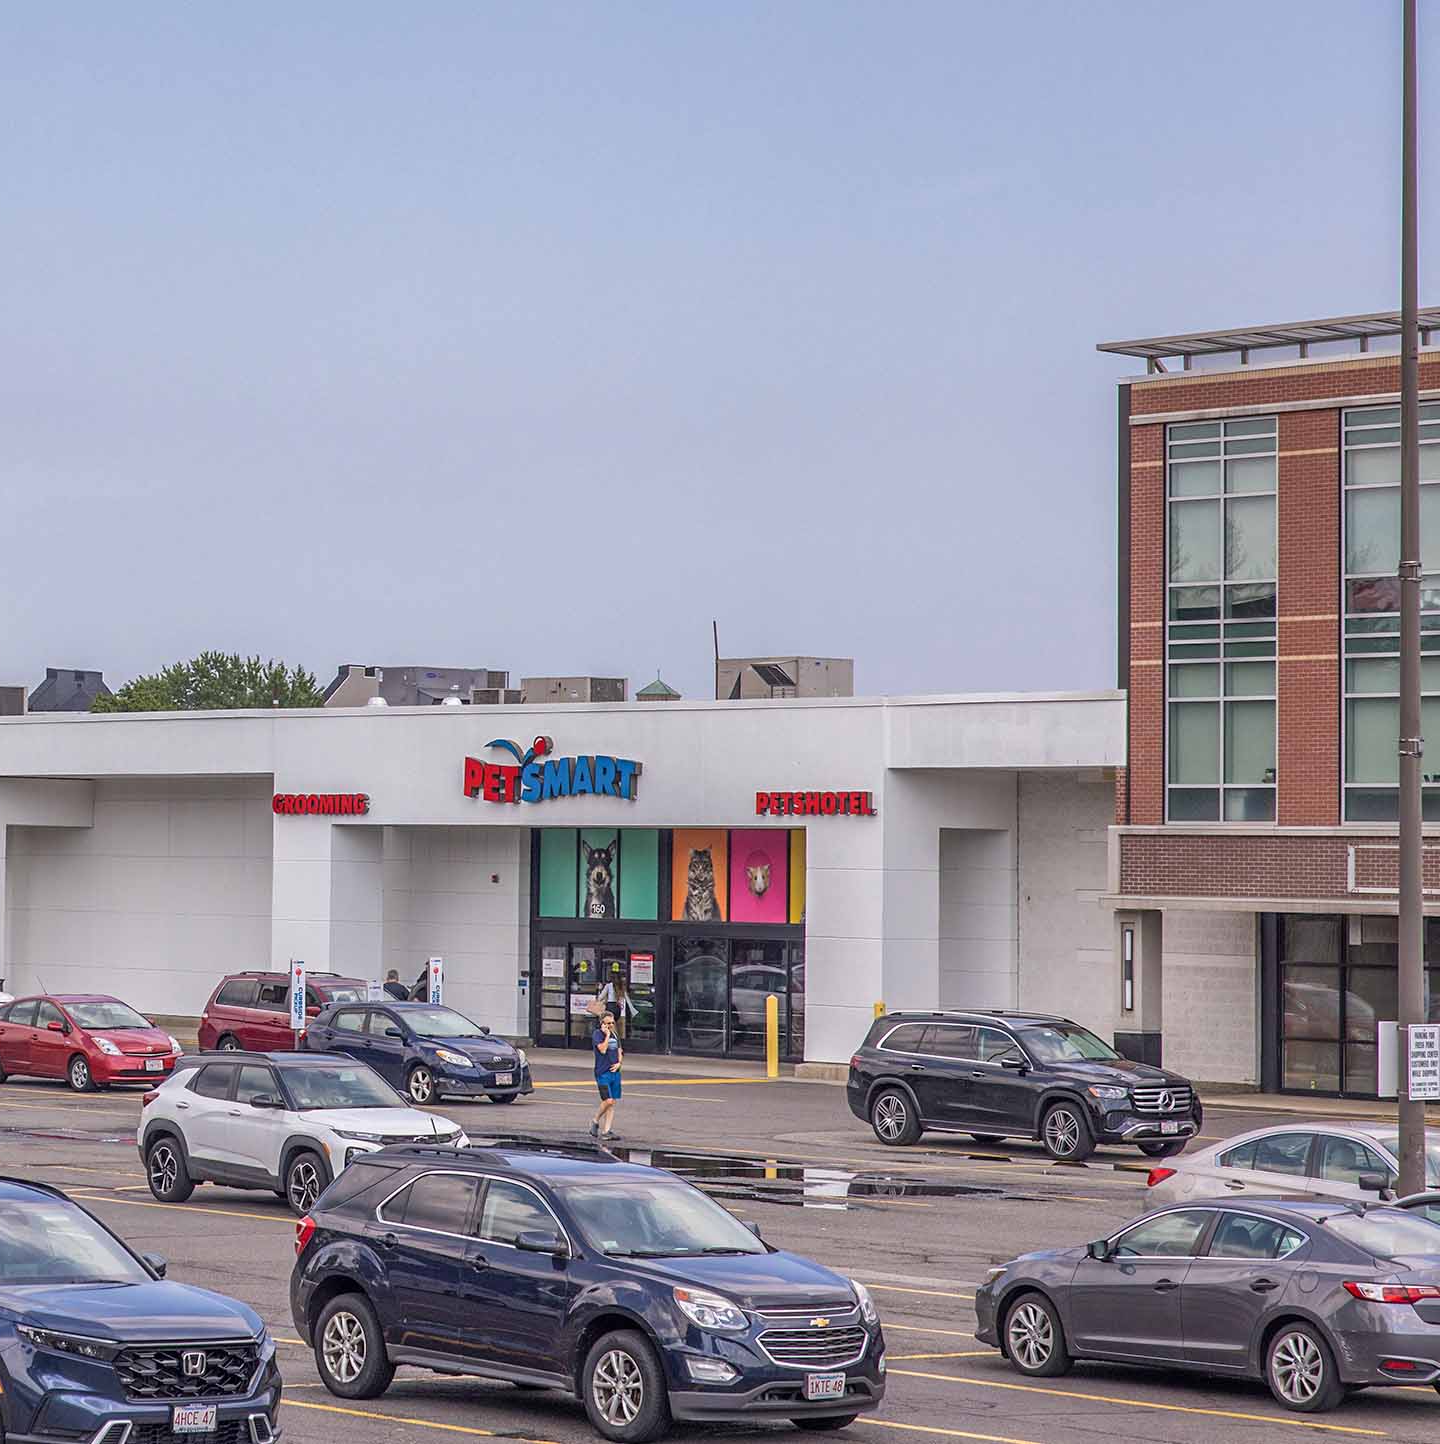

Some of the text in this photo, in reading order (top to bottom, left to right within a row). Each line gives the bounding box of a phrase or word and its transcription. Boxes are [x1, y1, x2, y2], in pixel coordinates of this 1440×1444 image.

[463, 754, 639, 803] PETSMART
[272, 793, 368, 815] GROOMING
[756, 791, 872, 816] PETSHOTEL
[592, 904, 606, 914] 160
[810, 1380, 844, 1394] 1KTE 48
[175, 1410, 215, 1426] 4HCE 47
